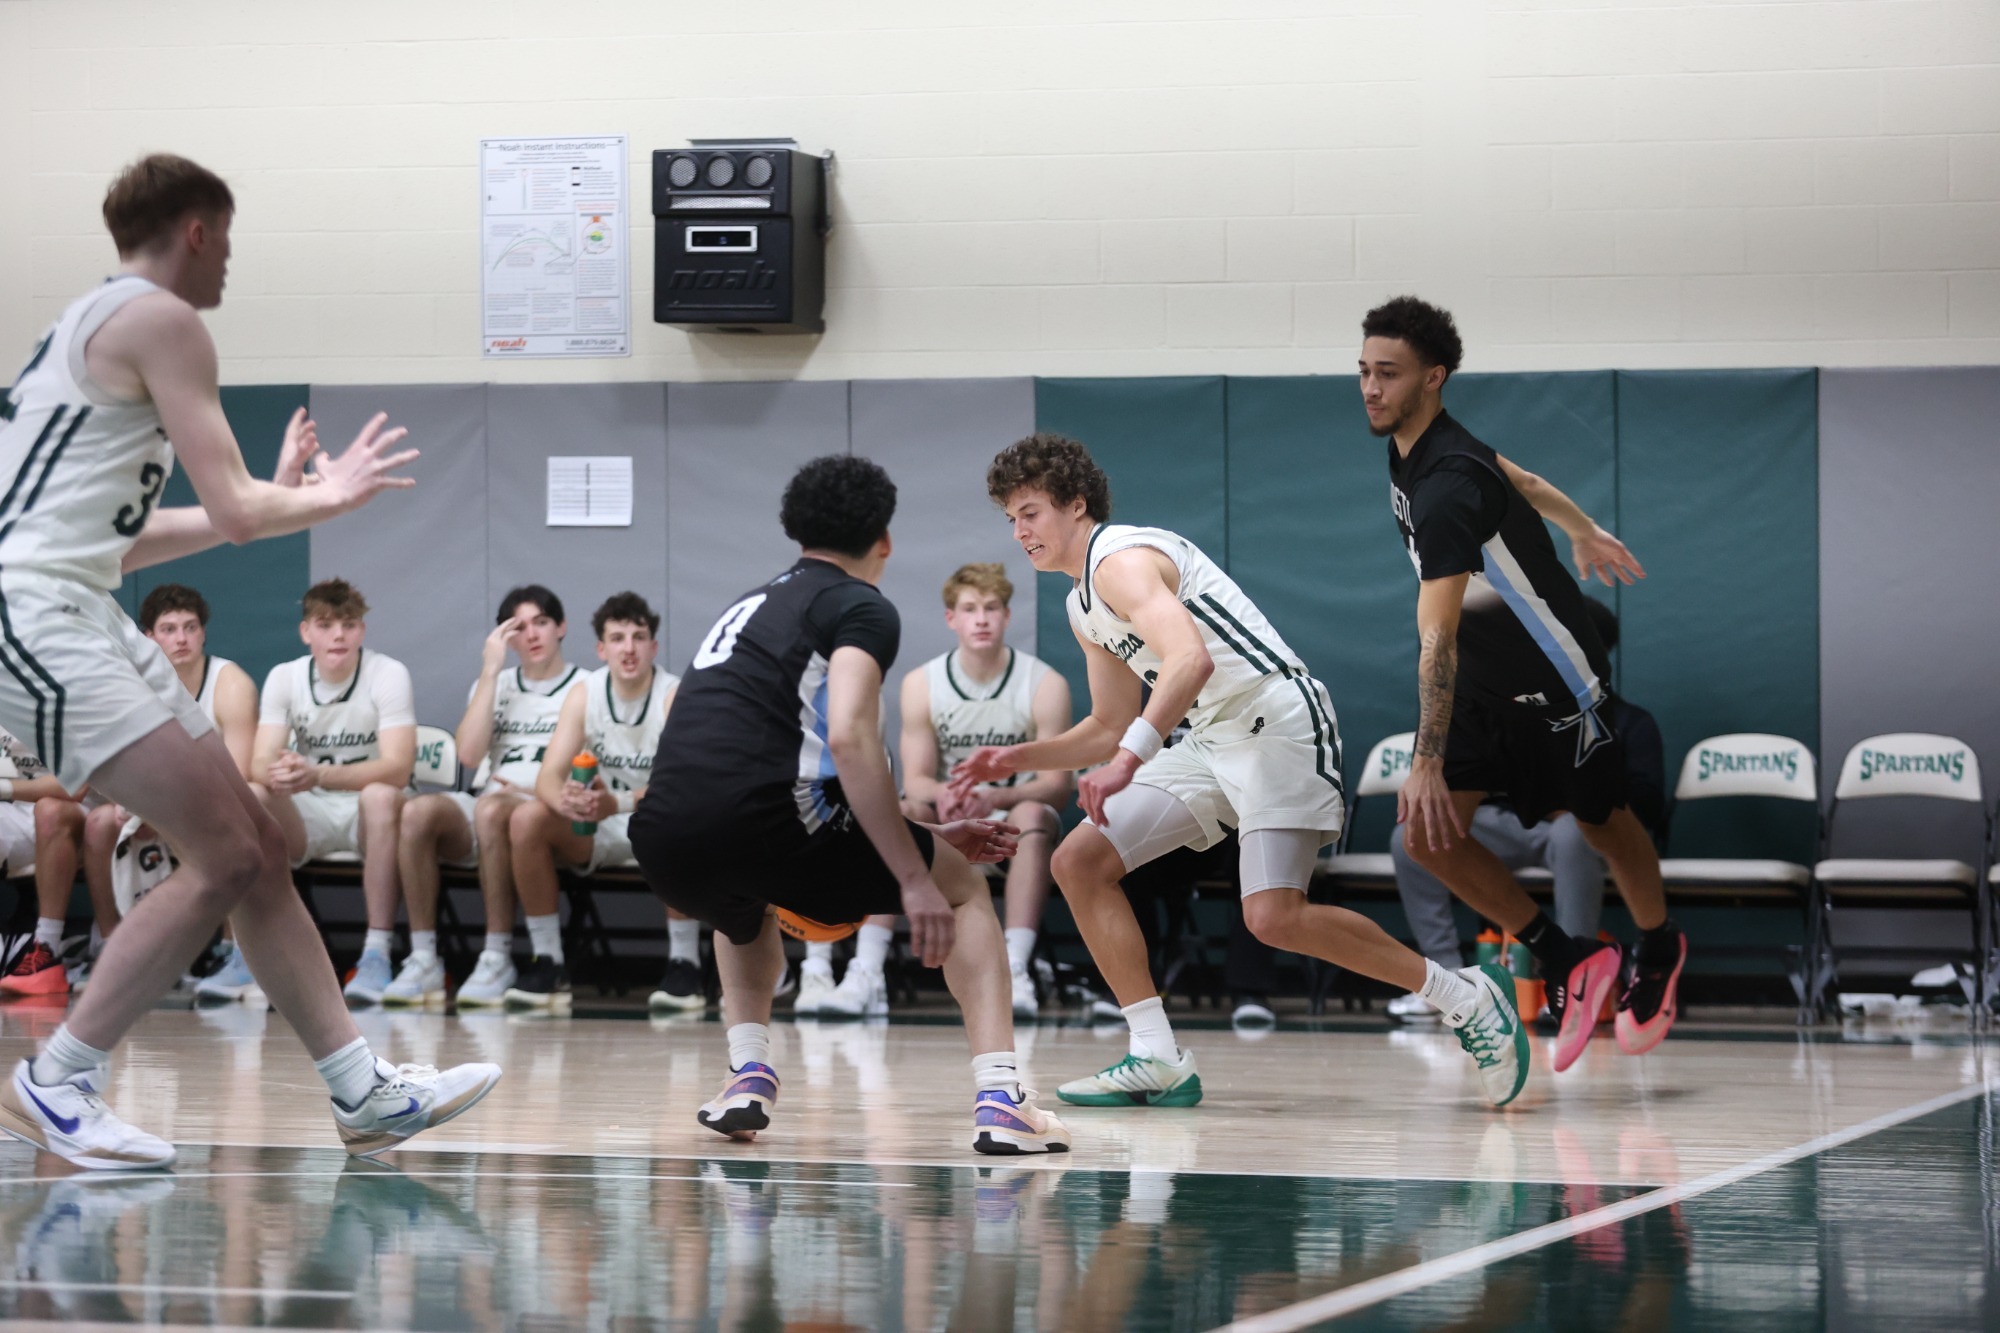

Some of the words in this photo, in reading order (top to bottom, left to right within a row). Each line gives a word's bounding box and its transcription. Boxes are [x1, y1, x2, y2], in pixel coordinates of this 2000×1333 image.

[555, 141, 606, 150] Instructions
[669, 259, 777, 290] noah
[692, 593, 768, 670] 0
[937, 722, 1028, 750] Spartans
[1698, 749, 1798, 782] SPARTANS
[1860, 749, 1965, 783] SPARTANS
